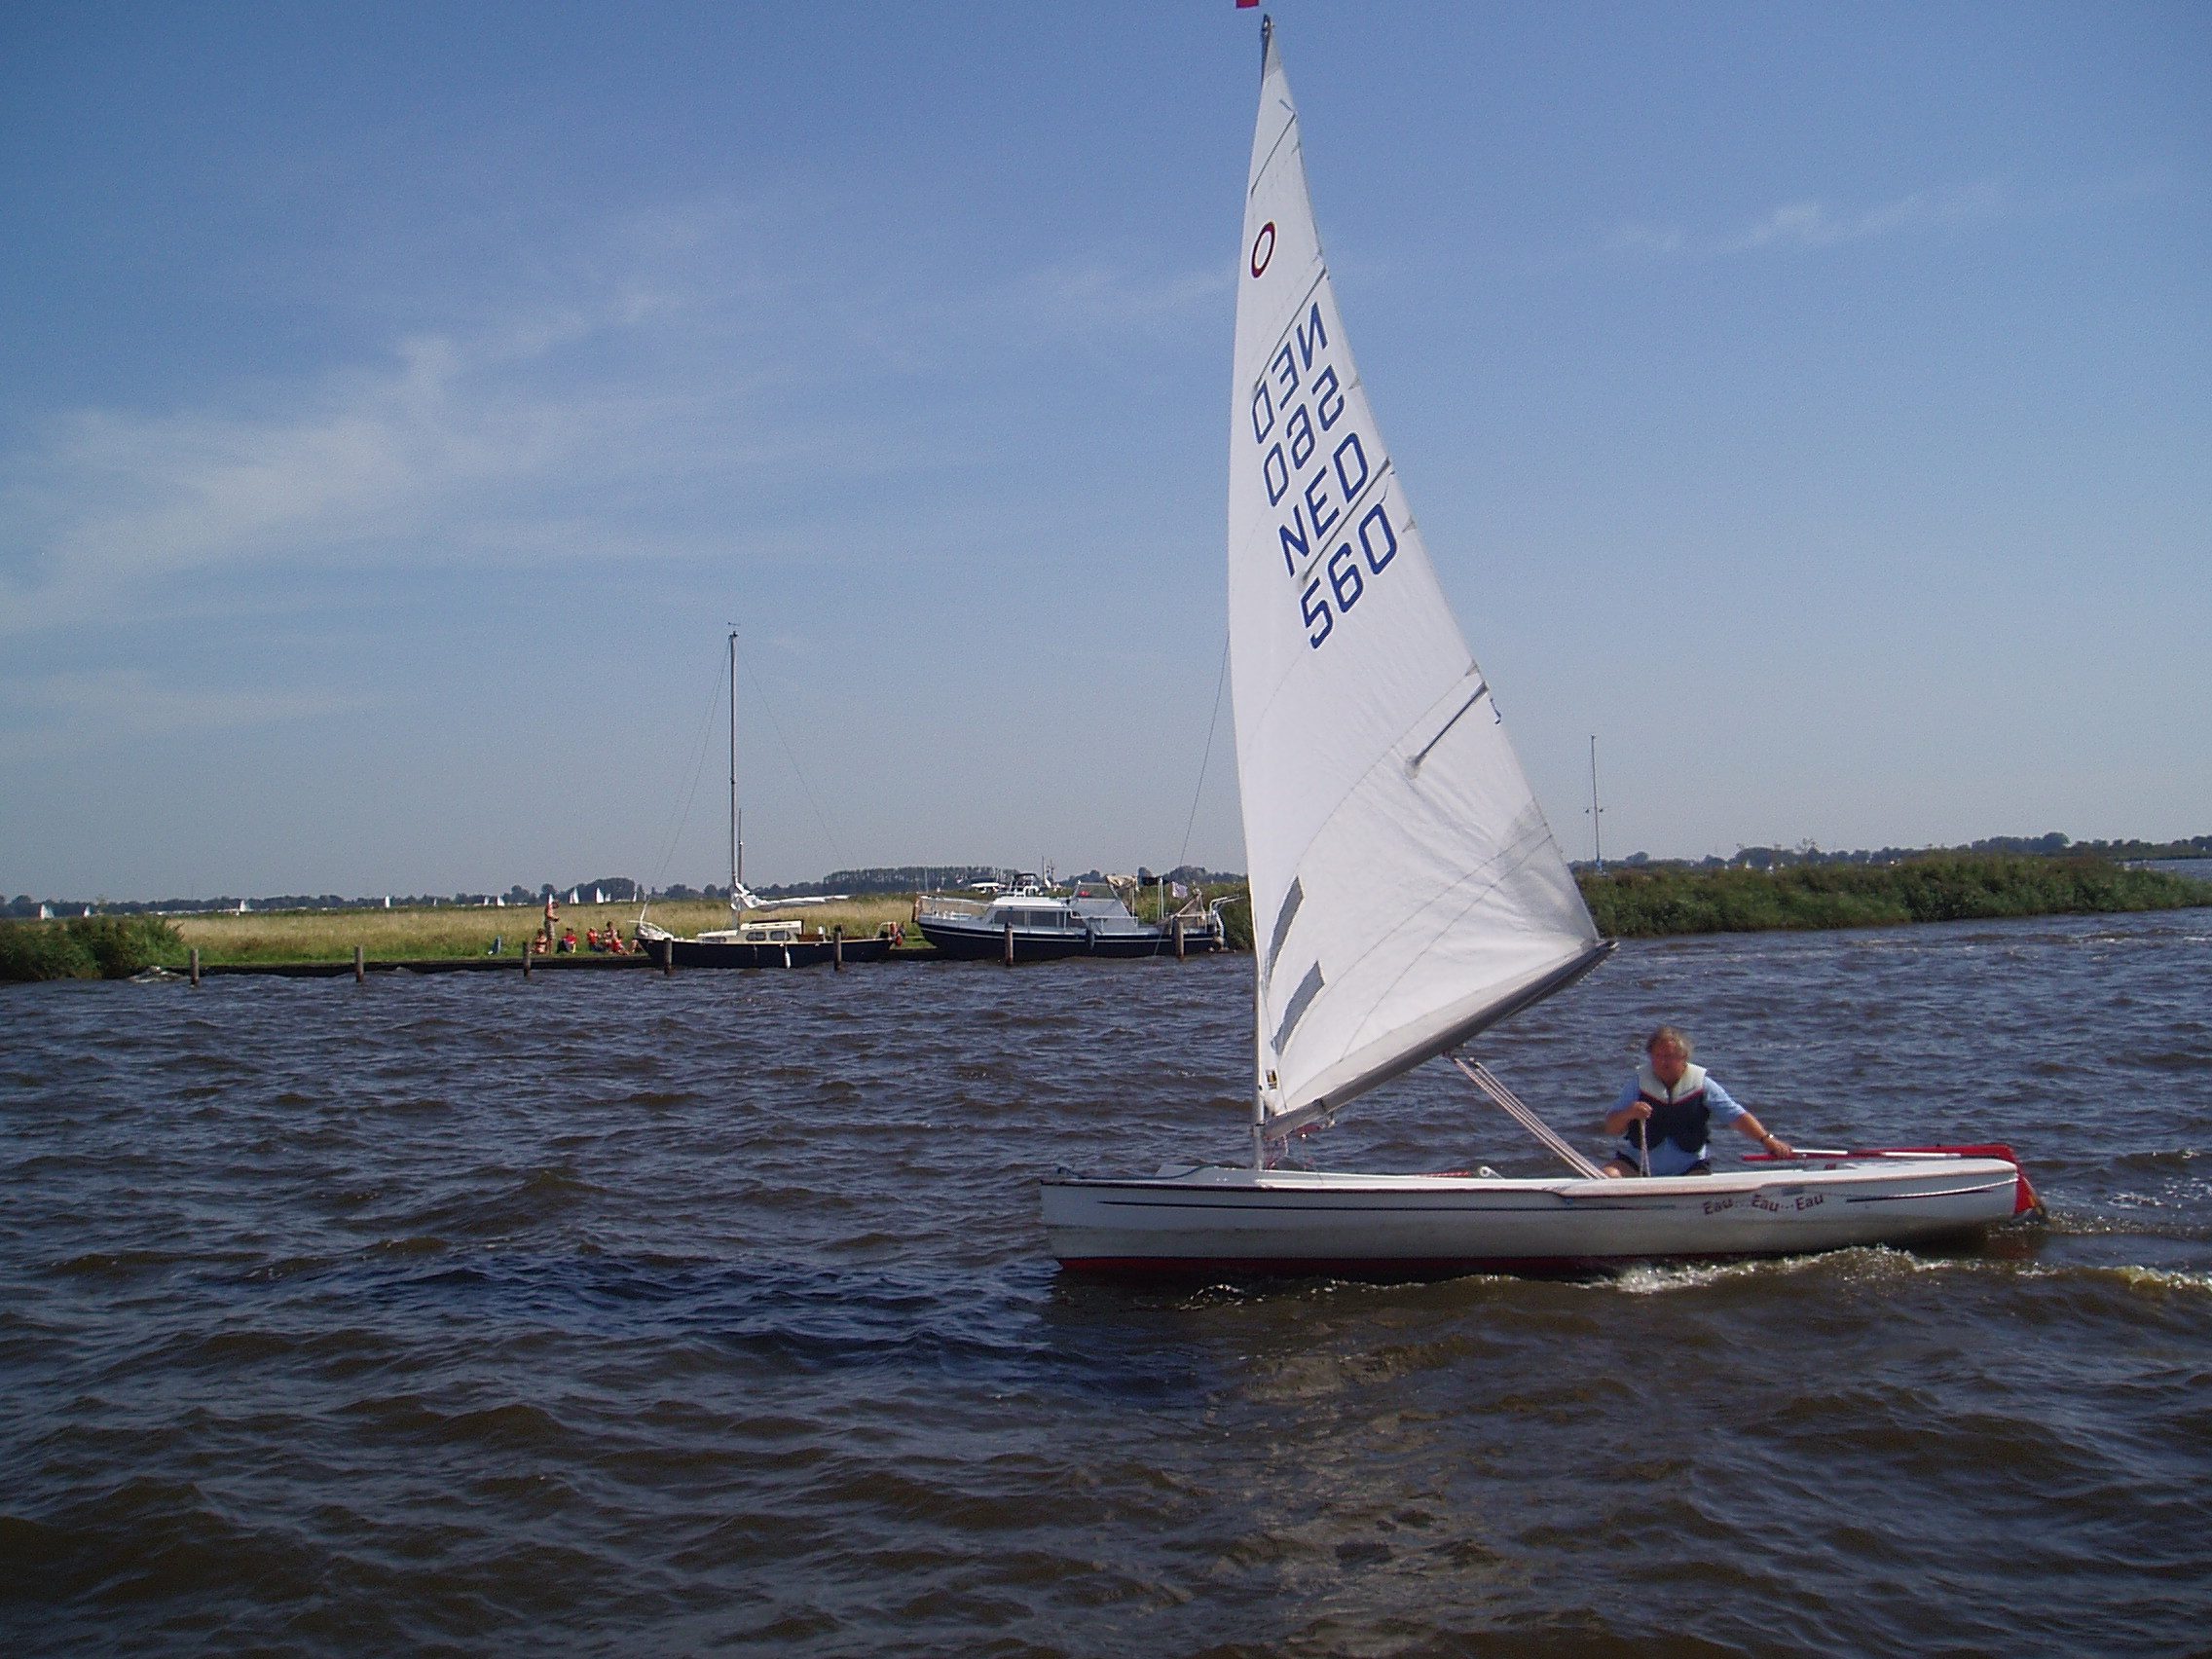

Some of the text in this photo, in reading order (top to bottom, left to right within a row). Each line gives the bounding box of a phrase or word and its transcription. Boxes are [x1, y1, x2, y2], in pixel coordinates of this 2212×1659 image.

[1278, 432, 1369, 577] NED
[1301, 503, 1397, 649] 560
[1795, 1194, 1824, 1211] Eau
